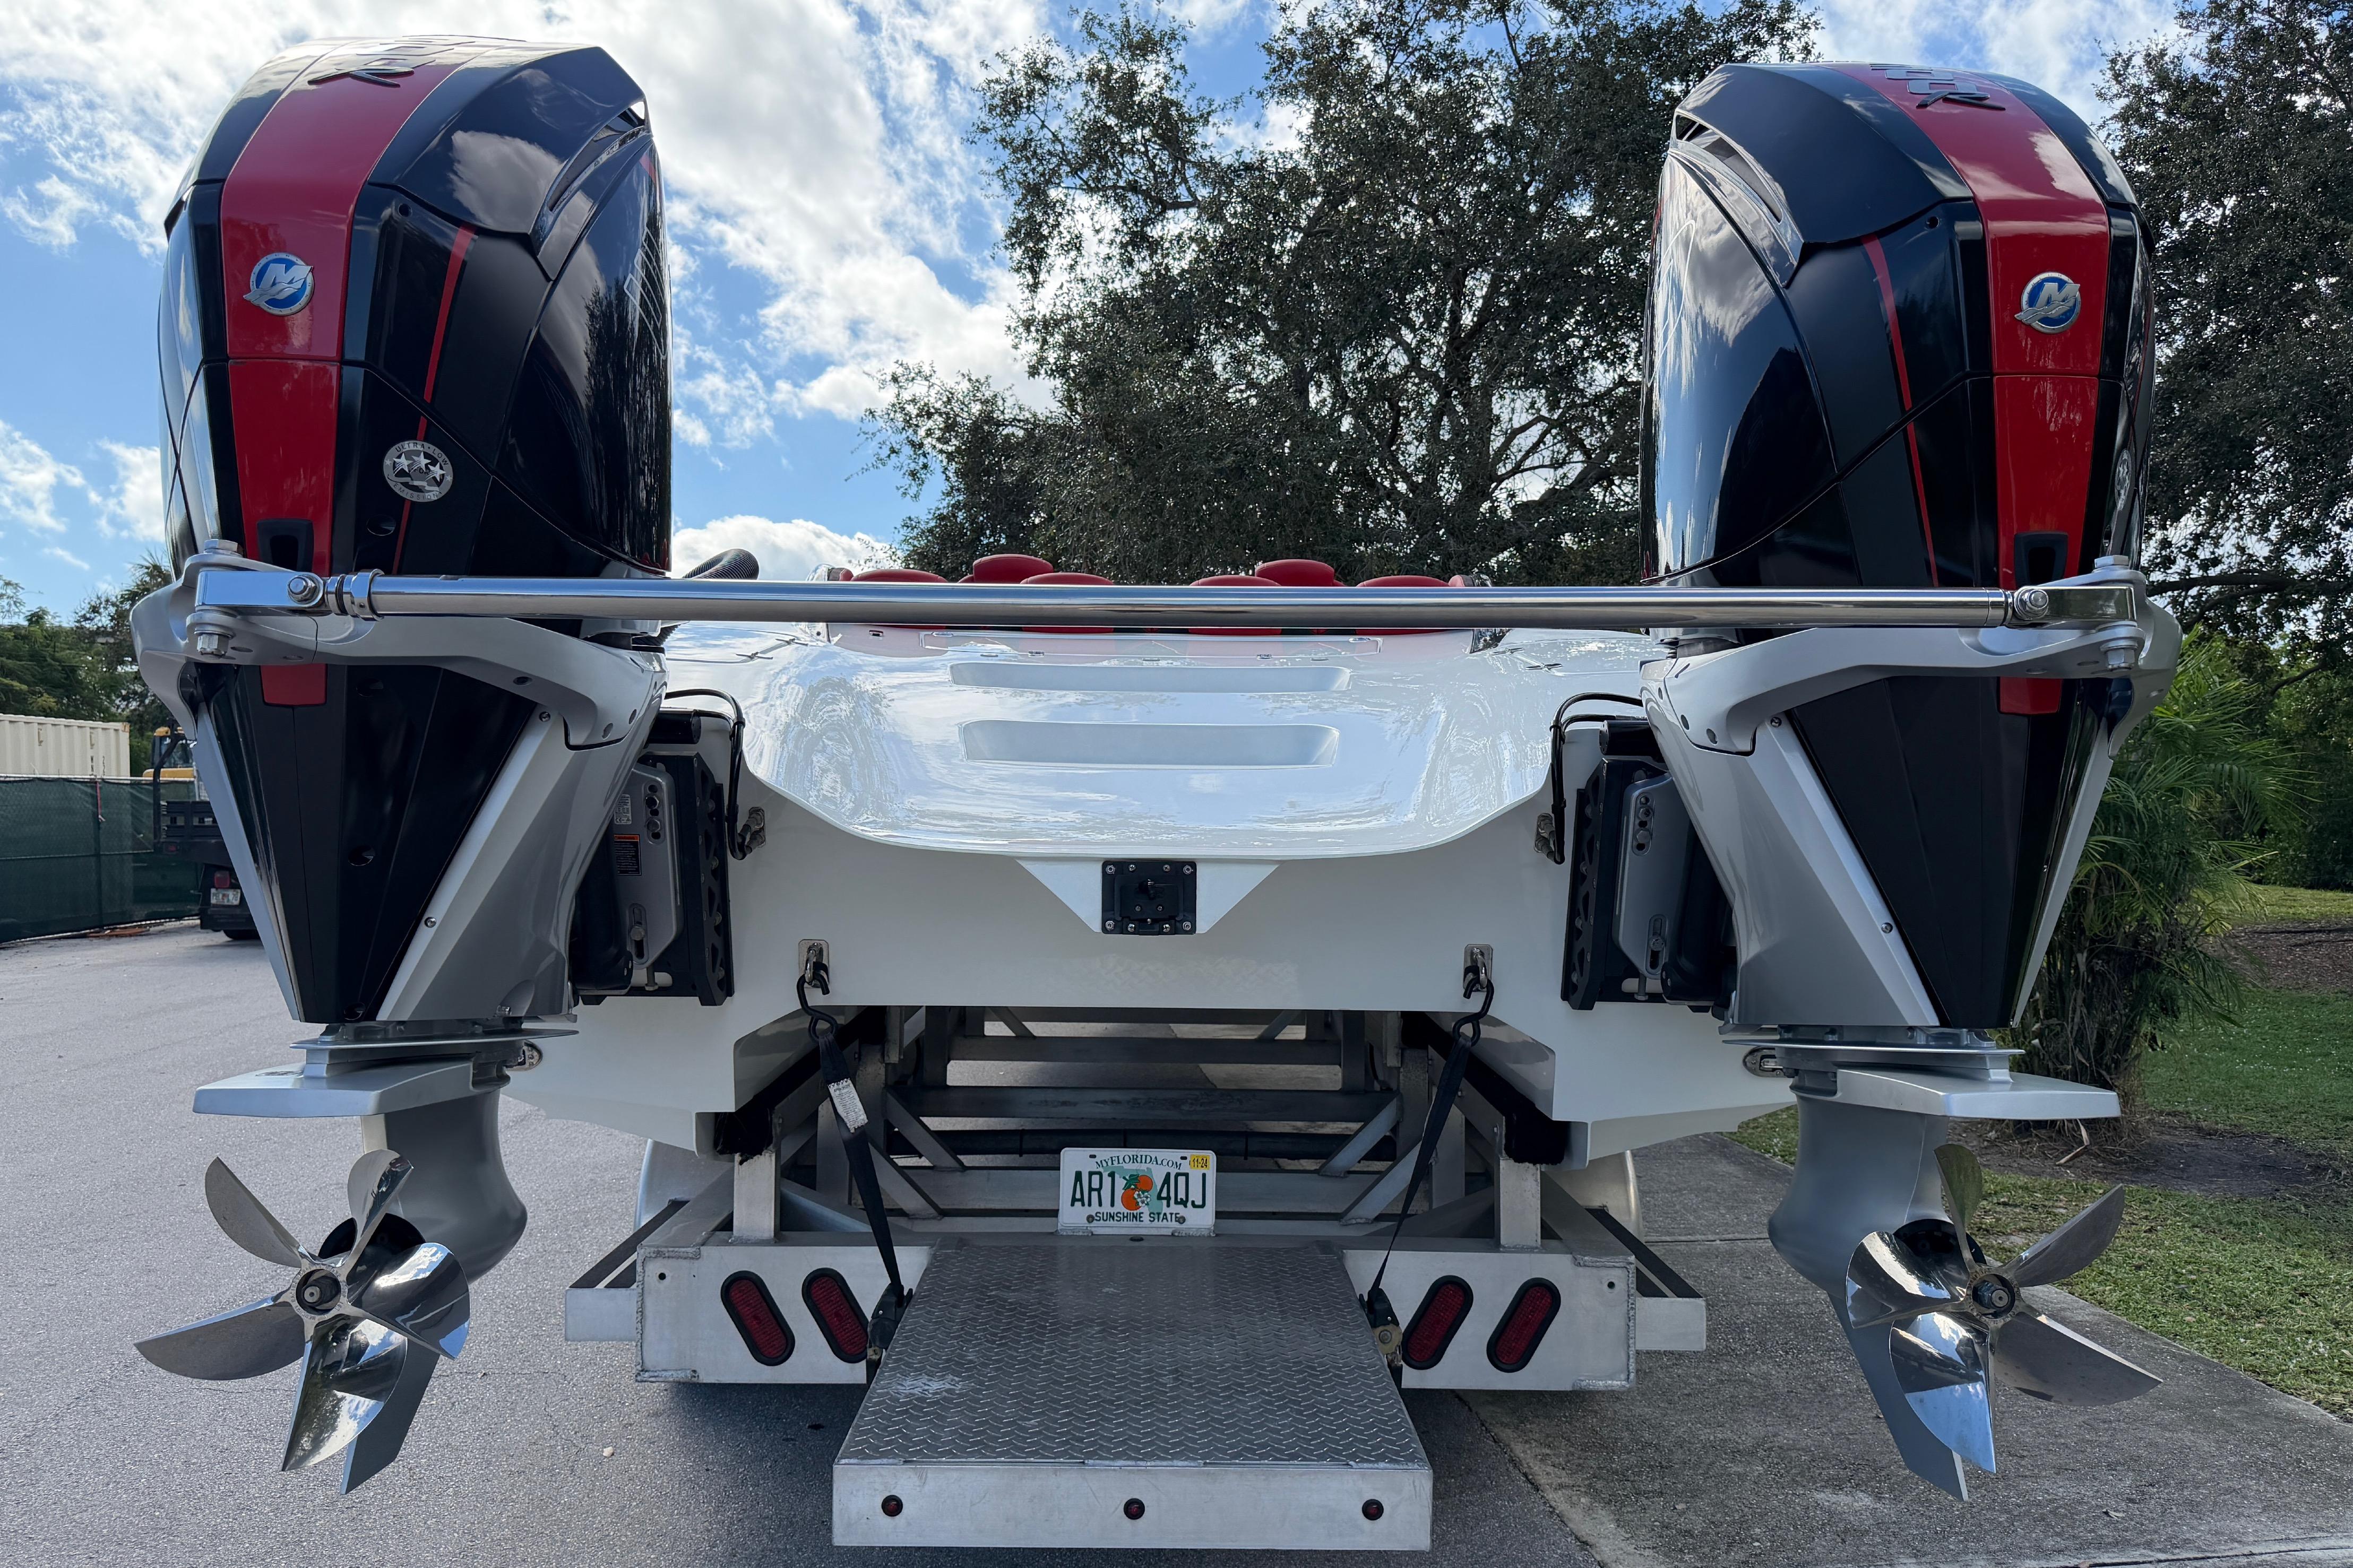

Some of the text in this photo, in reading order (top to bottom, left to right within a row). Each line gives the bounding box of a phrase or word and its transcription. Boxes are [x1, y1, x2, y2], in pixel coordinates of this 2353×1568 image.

[395, 442, 449, 466] ULTRA LOW
[393, 483, 438, 500] EMISSION
[1096, 1154, 1182, 1170] MYFLORIDA.COM
[1070, 1171, 1206, 1208] AR1 4QJ
[1094, 1212, 1180, 1223] SUNSHINE STATE
